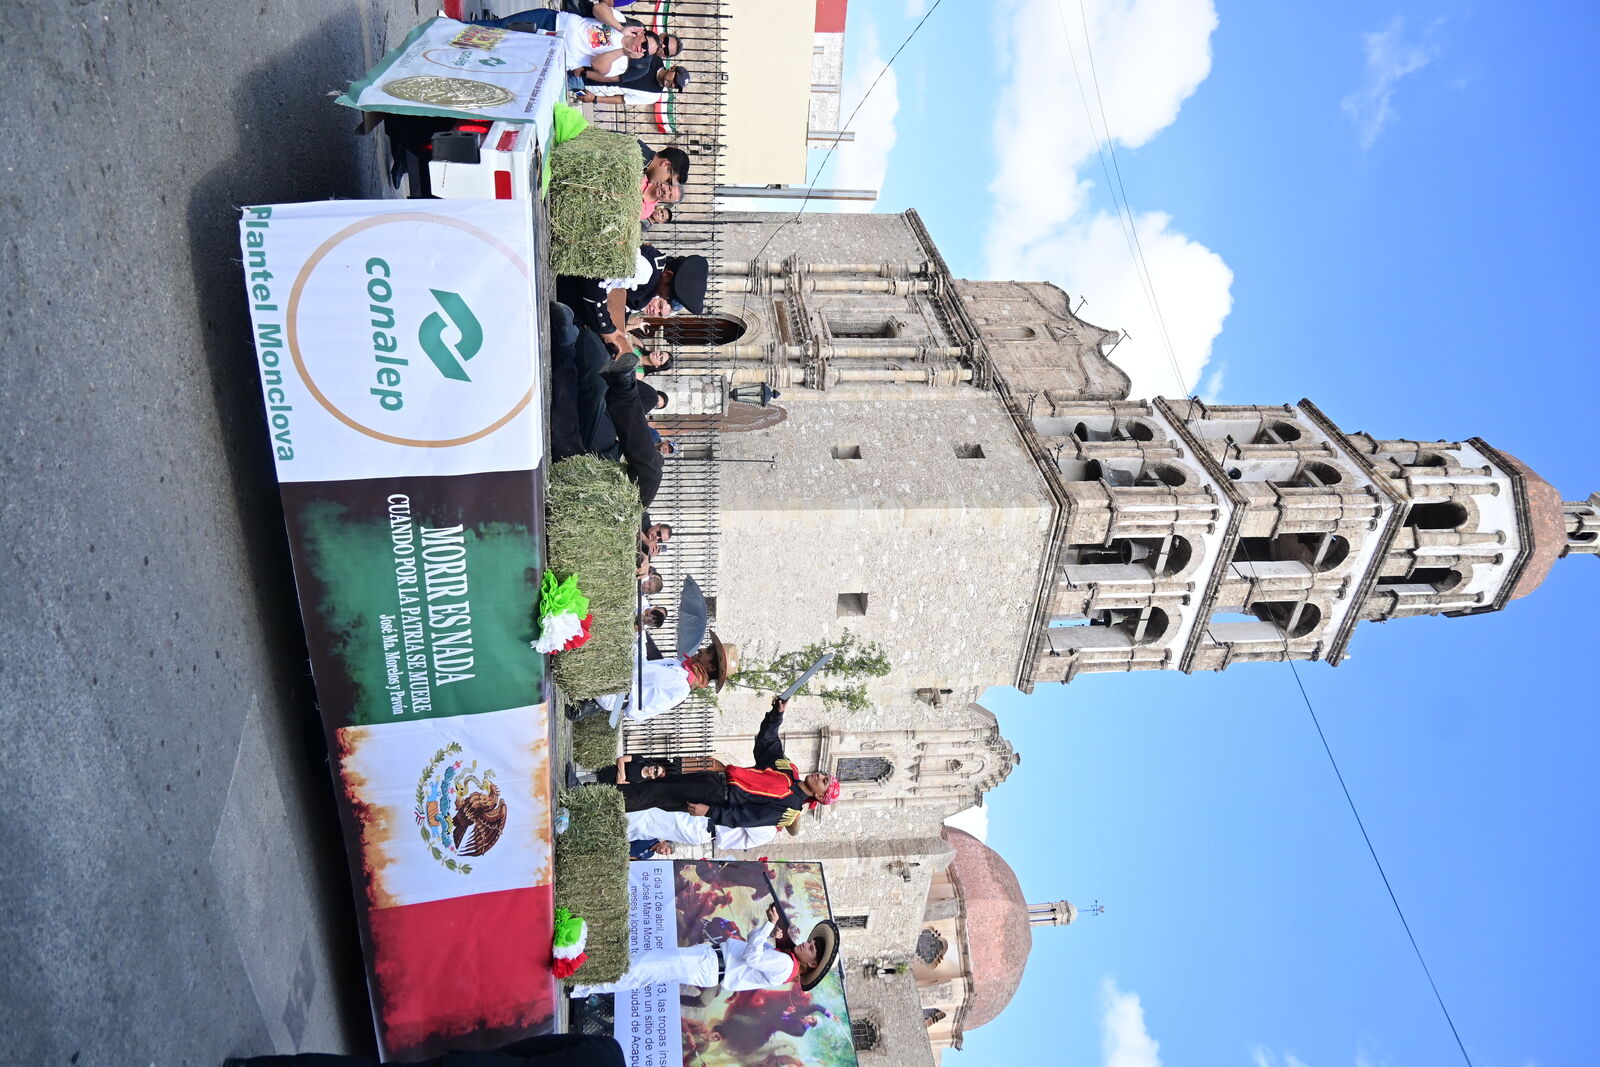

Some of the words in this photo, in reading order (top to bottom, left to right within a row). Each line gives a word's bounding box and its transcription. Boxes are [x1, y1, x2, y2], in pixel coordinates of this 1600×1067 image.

[246, 207, 278, 311] Plantel
[365, 257, 408, 411] conalep
[258, 324, 295, 462] Monclova
[387, 494, 414, 554] CUANDO
[394, 557, 418, 584] POR
[420, 524, 468, 601] MORIR
[398, 587, 420, 605] LA
[379, 614, 396, 633] José
[428, 601, 471, 628] ES
[401, 606, 424, 653] PATRIA
[382, 635, 398, 650] Ma.
[385, 652, 403, 684] Morelos
[408, 654, 426, 669] SE
[431, 629, 476, 686] NADA
[409, 671, 432, 713] MUERE
[390, 691, 408, 715] Pavón
[642, 872, 650, 881] de
[654, 868, 663, 876] El
[631, 886, 639, 911] meses
[655, 891, 664, 900] 12
[655, 902, 664, 912] de
[629, 920, 640, 945] logran
[655, 913, 665, 934] abril,
[643, 927, 653, 950] Morel
[654, 936, 664, 949] per
[657, 983, 666, 996] 13,
[645, 1000, 654, 1013] un
[658, 999, 668, 1012] las
[631, 1020, 641, 1033] de
[645, 1015, 655, 1036] sitio
[655, 1015, 668, 1047] tropas
[629, 1035, 641, 1067] Acapu
[645, 1038, 655, 1050] de
[645, 1054, 653, 1067] ve
[659, 1050, 669, 1067] ins
